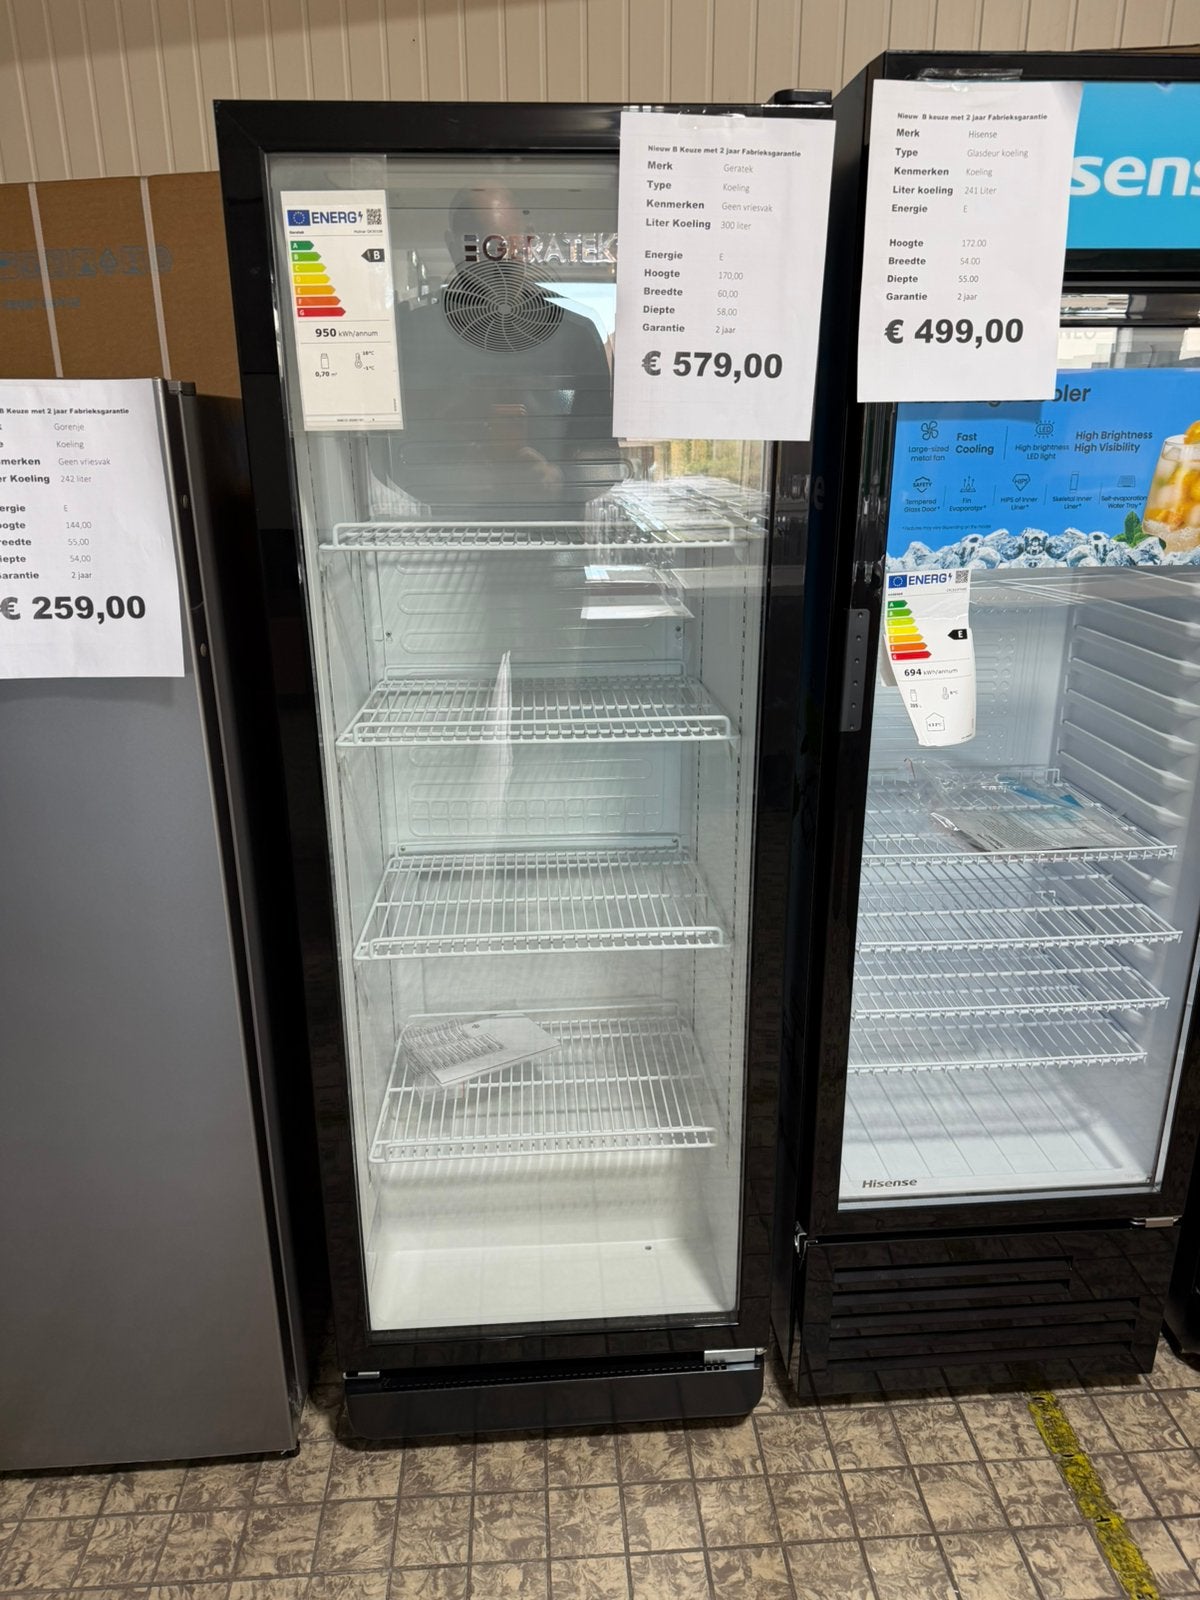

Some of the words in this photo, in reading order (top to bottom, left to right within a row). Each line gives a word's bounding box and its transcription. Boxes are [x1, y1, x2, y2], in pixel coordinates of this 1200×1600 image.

[897, 112, 918, 120] Nieuw
[972, 114, 986, 122] jaar
[988, 113, 1048, 122] Fabrieksgarantie
[896, 128, 920, 138] Merk
[968, 130, 998, 139] Hisense
[680, 146, 702, 154] Keuze
[726, 147, 740, 156] jaar
[742, 148, 802, 158] Fabrieksgarantie
[895, 148, 918, 158] Type
[967, 149, 1000, 158] Glasdeur
[1001, 149, 1028, 159] koeling
[647, 160, 673, 170] Merk
[723, 164, 754, 173] Geratek
[894, 166, 950, 176] Kenmerken
[966, 168, 993, 178] Koeling
[1070, 155, 1200, 197] sen
[647, 180, 672, 190] Type
[722, 183, 750, 194] Koeling
[892, 186, 915, 194] Liter
[917, 186, 954, 196] koeling
[964, 186, 978, 195] 241
[980, 186, 997, 195] Liter
[646, 199, 705, 210] Kenmerken
[722, 202, 742, 211] Geen
[742, 203, 773, 213] vriesvak
[892, 204, 928, 214] Energie
[963, 205, 968, 213] E
[312, 211, 358, 224] ENERG
[646, 218, 670, 228] Liter
[672, 219, 711, 230] Koeling
[720, 221, 736, 230] 300
[736, 221, 752, 230] liter
[482, 232, 618, 263] GERATEK
[890, 238, 924, 249] Hoogte
[962, 239, 987, 248] 172.00
[373, 250, 381, 260] B
[644, 250, 684, 260] Energie
[719, 253, 724, 261] E
[888, 257, 926, 266] Breedte
[960, 257, 980, 266] 54.00
[644, 268, 680, 279] Hoogte
[718, 272, 744, 282] 170,00
[887, 275, 918, 284] Diepte
[958, 275, 979, 284] 55.00
[644, 287, 683, 296] Breedte
[717, 290, 738, 300] 60,00
[886, 292, 928, 301] Garantie
[963, 292, 978, 302] jaar
[643, 306, 675, 316] Diepte
[716, 308, 738, 318] 58,00
[315, 328, 337, 338] 950
[338, 330, 378, 338] kWh/annum
[642, 324, 685, 332] Garantie
[715, 326, 720, 334] 2
[721, 326, 736, 336] jaar
[884, 319, 904, 344] €
[914, 318, 1024, 349] 499,00
[641, 350, 662, 376] €
[672, 352, 783, 384] 579,00
[53, 408, 68, 416] jaar
[69, 408, 130, 416] Fabrieksgarantie
[54, 422, 85, 432] Gorenje
[956, 432, 978, 442] Fast
[1076, 431, 1099, 442] High
[1101, 430, 1153, 442] Brightness
[56, 440, 84, 450] Koeling
[908, 445, 950, 454] Large-sized
[955, 444, 995, 455] Cooling
[1015, 444, 1032, 452] High
[1032, 444, 1070, 452] brightness
[1074, 443, 1097, 454] High
[1099, 442, 1141, 454] Visibility
[0, 457, 41, 466] merken
[58, 457, 78, 466] Geen
[80, 457, 111, 466] vriesvak
[911, 454, 932, 462] metal
[1040, 453, 1056, 461] light
[10, 474, 50, 485] Koeling
[60, 474, 76, 484] 242
[77, 474, 92, 484] liter
[905, 498, 937, 506] Tempered
[65, 521, 92, 531] 144,00
[68, 538, 90, 547] 55,00
[70, 554, 92, 564] 54,00
[0, 570, 40, 580] arantie
[71, 571, 76, 580] 2
[78, 571, 92, 581] jaar
[908, 573, 948, 586] ENERG
[0, 596, 21, 620] €
[32, 596, 146, 625] 259,00
[958, 630, 964, 638] E
[904, 668, 922, 677] 694
[862, 1178, 918, 1189] Hisense
